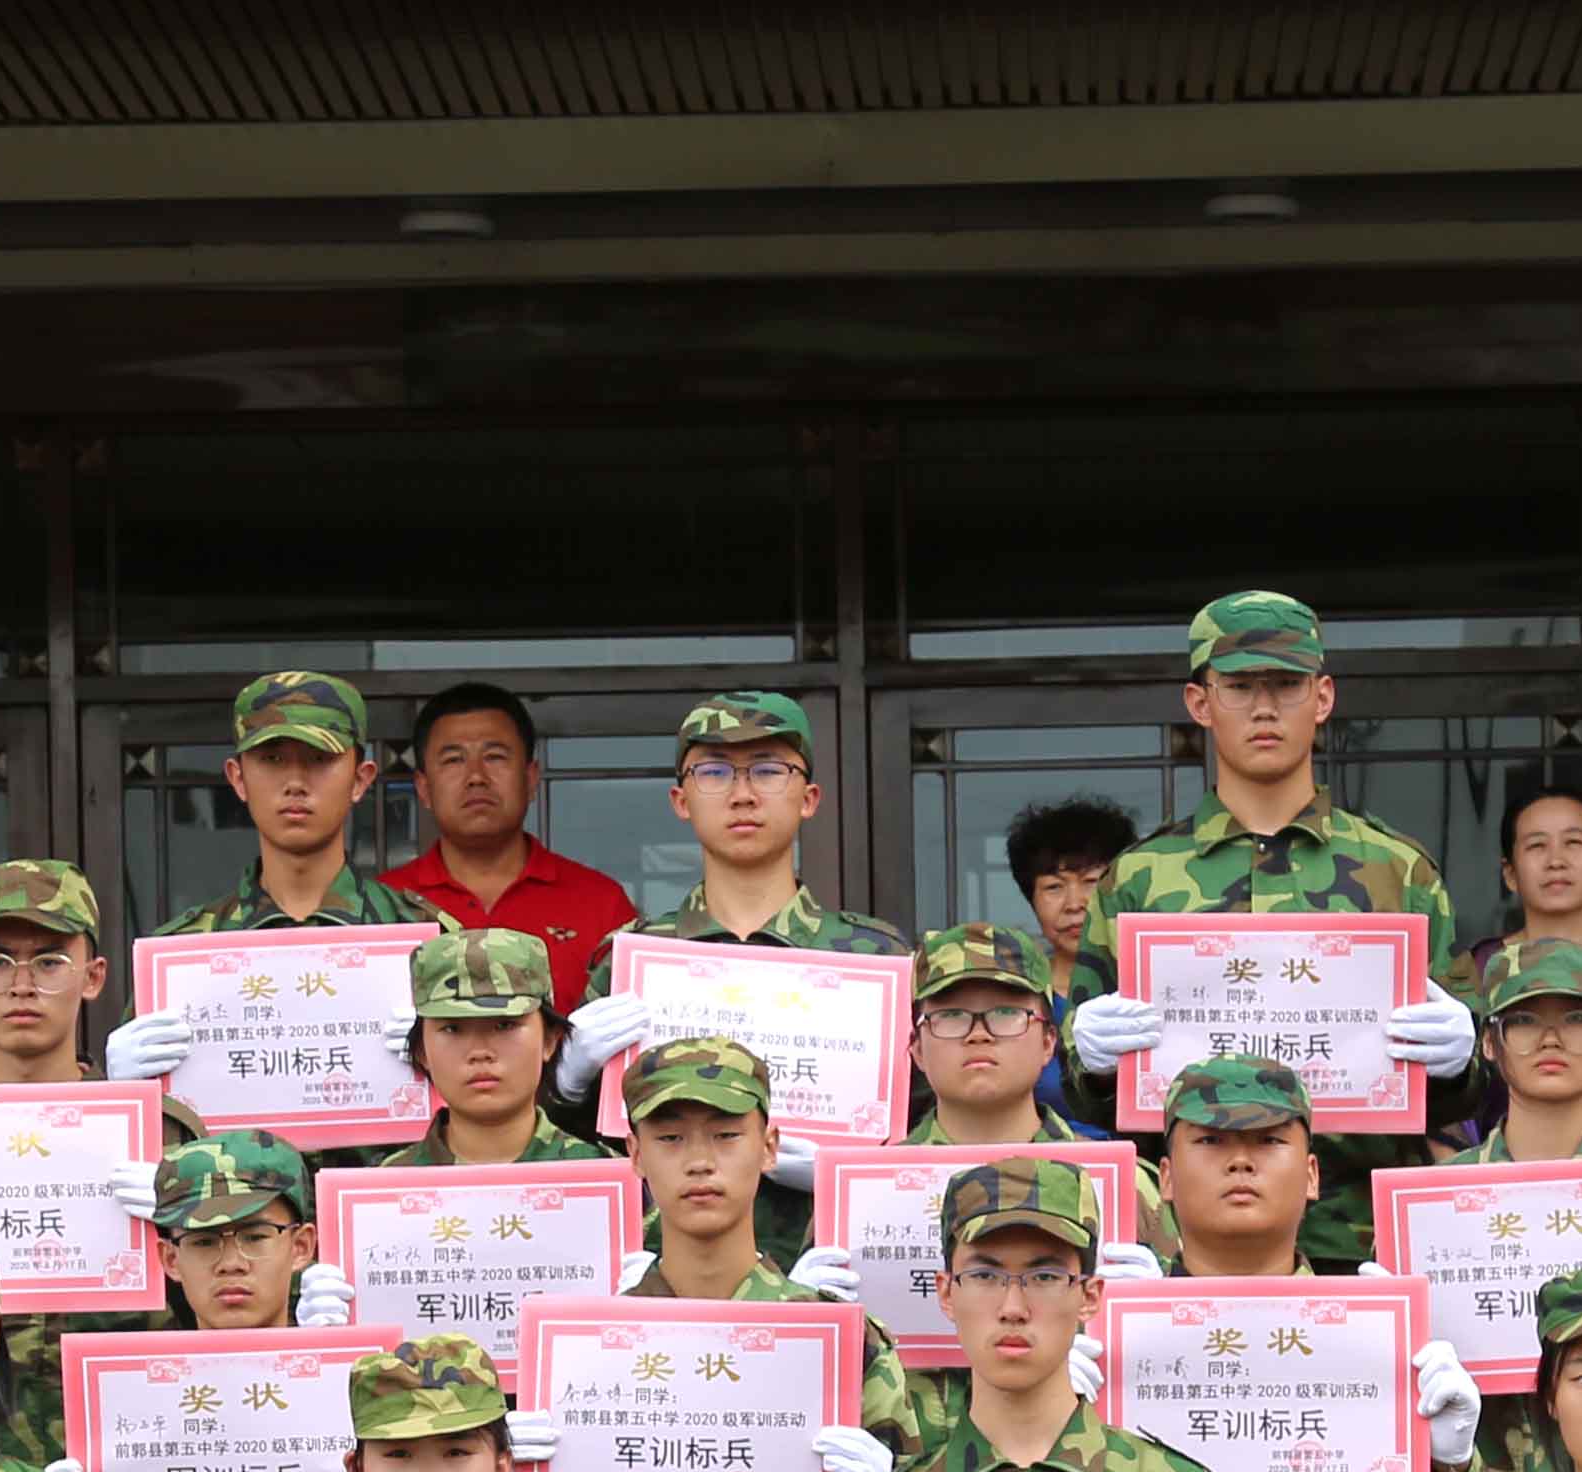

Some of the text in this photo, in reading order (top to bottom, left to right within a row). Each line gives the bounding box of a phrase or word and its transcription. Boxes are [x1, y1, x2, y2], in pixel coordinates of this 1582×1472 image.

[238, 972, 337, 1000] 奖状
[1223, 959, 1321, 984] 奖状
[1209, 1033, 1333, 1061] 军训标兵
[228, 1047, 353, 1079] 军训标兵
[429, 1215, 532, 1243] 奖状
[416, 1290, 543, 1323] 军训标
[1475, 1290, 1538, 1321] 军训
[1203, 1328, 1314, 1357] 奖状
[631, 1353, 740, 1381] 奖状
[179, 1383, 288, 1414] 奖状
[1187, 1409, 1327, 1442] 军训标兵
[614, 1437, 755, 1469] 军训标兵
